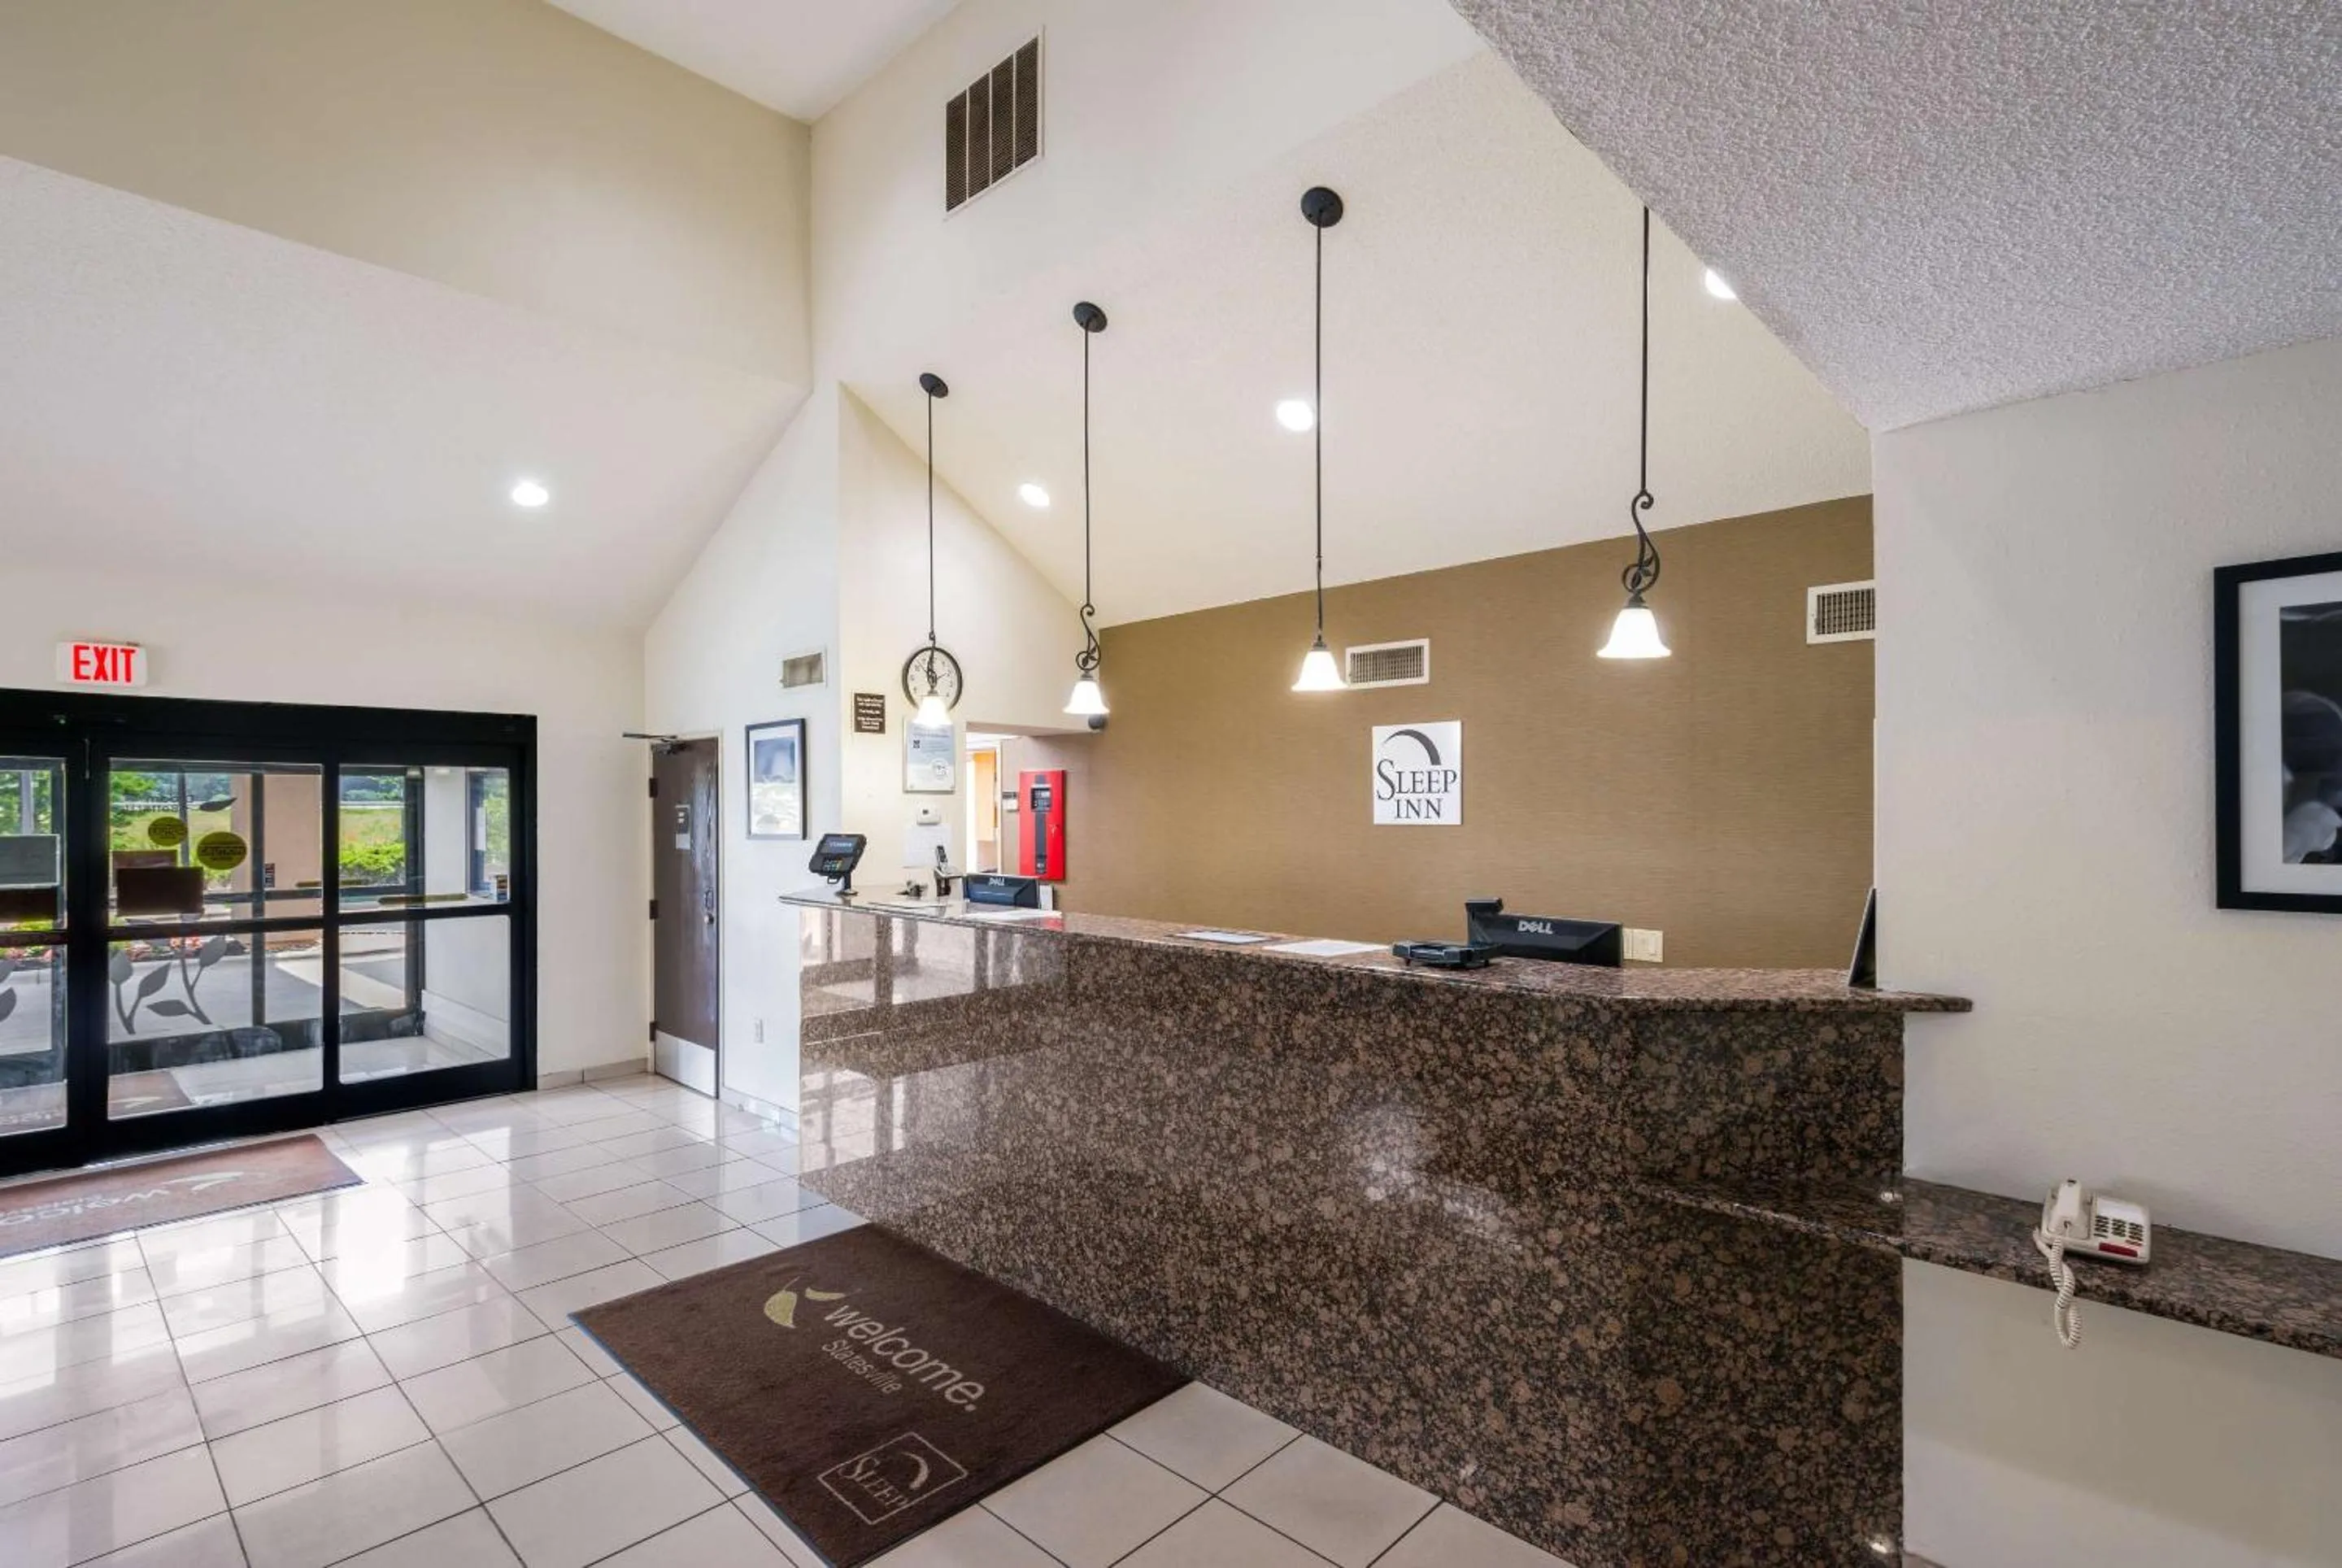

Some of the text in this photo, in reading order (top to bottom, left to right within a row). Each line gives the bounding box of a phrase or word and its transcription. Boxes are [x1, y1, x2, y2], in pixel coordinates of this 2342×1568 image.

[73, 644, 137, 683] EXIT
[1377, 758, 1457, 800] SLEEP
[1394, 798, 1443, 819] INN
[1517, 920, 1554, 934] DELL
